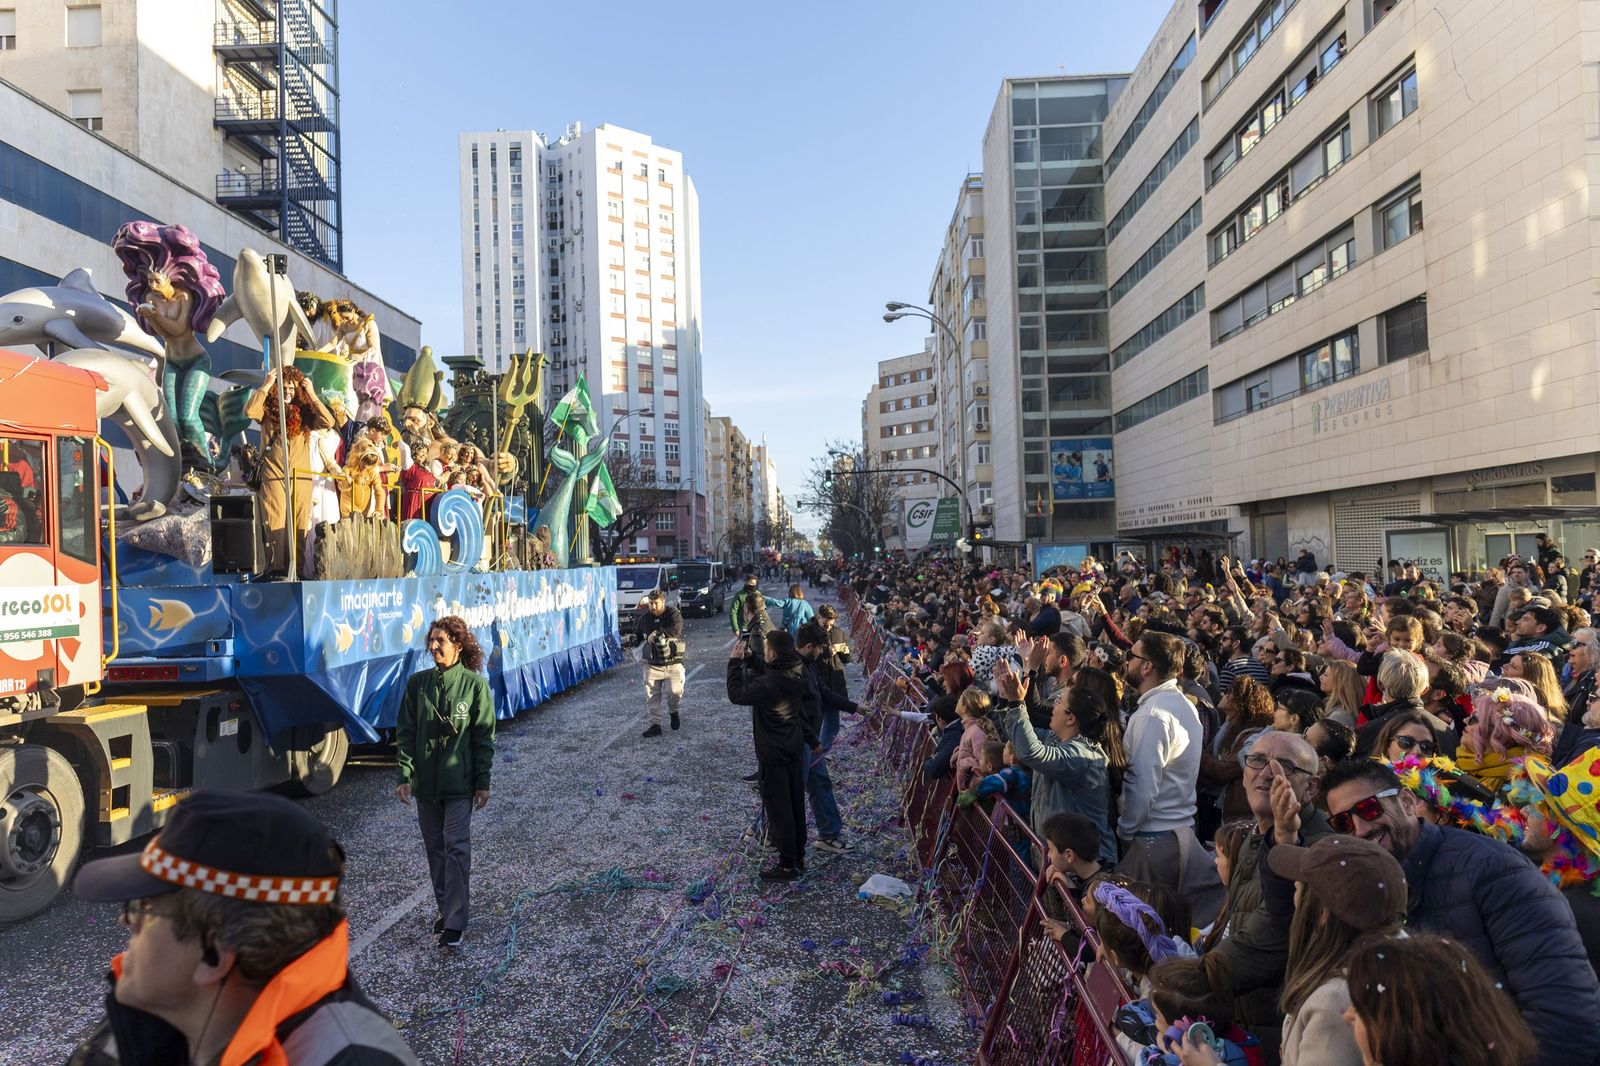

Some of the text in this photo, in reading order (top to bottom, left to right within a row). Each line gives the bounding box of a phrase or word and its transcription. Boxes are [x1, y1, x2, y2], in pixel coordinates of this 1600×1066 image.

[1324, 377, 1392, 417] PREVENTIVA
[1323, 404, 1393, 432] SEGUROS
[912, 509, 935, 520] CSIF
[1430, 557, 1443, 566] es
[340, 583, 404, 613] imaginarte
[3, 631, 21, 641] 956
[21, 630, 37, 640] 546
[37, 629, 53, 638] 388
[14, 678, 27, 691] T2i
